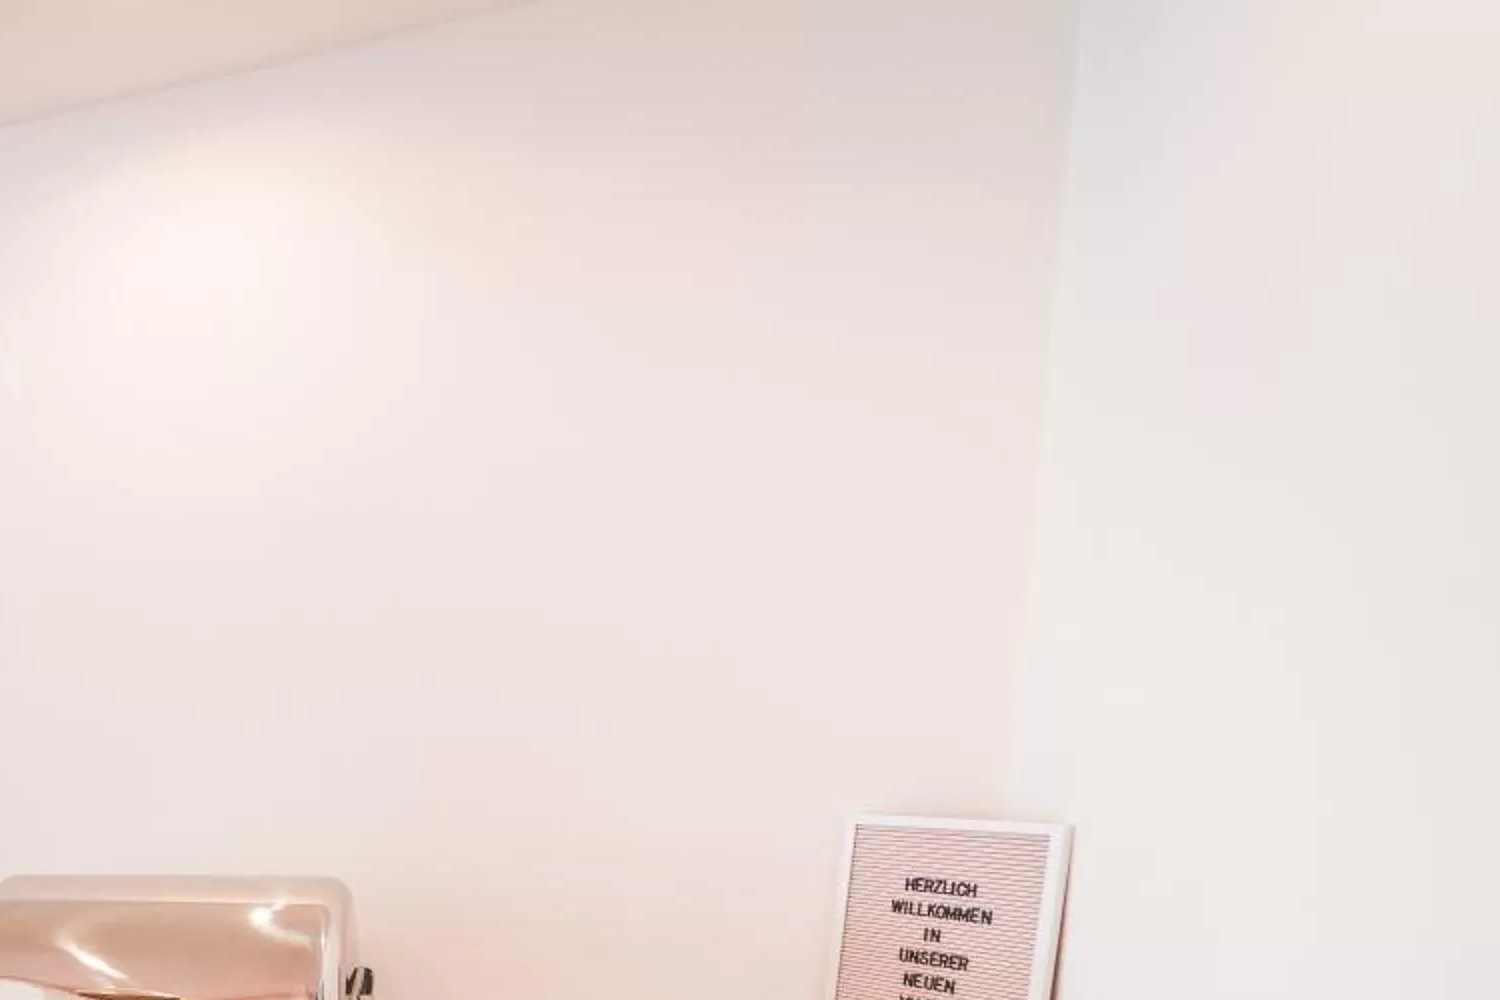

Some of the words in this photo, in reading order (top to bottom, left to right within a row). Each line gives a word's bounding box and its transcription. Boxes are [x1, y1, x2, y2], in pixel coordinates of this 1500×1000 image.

[905, 877, 978, 897] HERZLICH
[891, 898, 993, 925] WILLKOMMEN
[923, 927, 941, 943] IN
[899, 947, 969, 971] UNSERER
[903, 973, 956, 995] NEUEN
